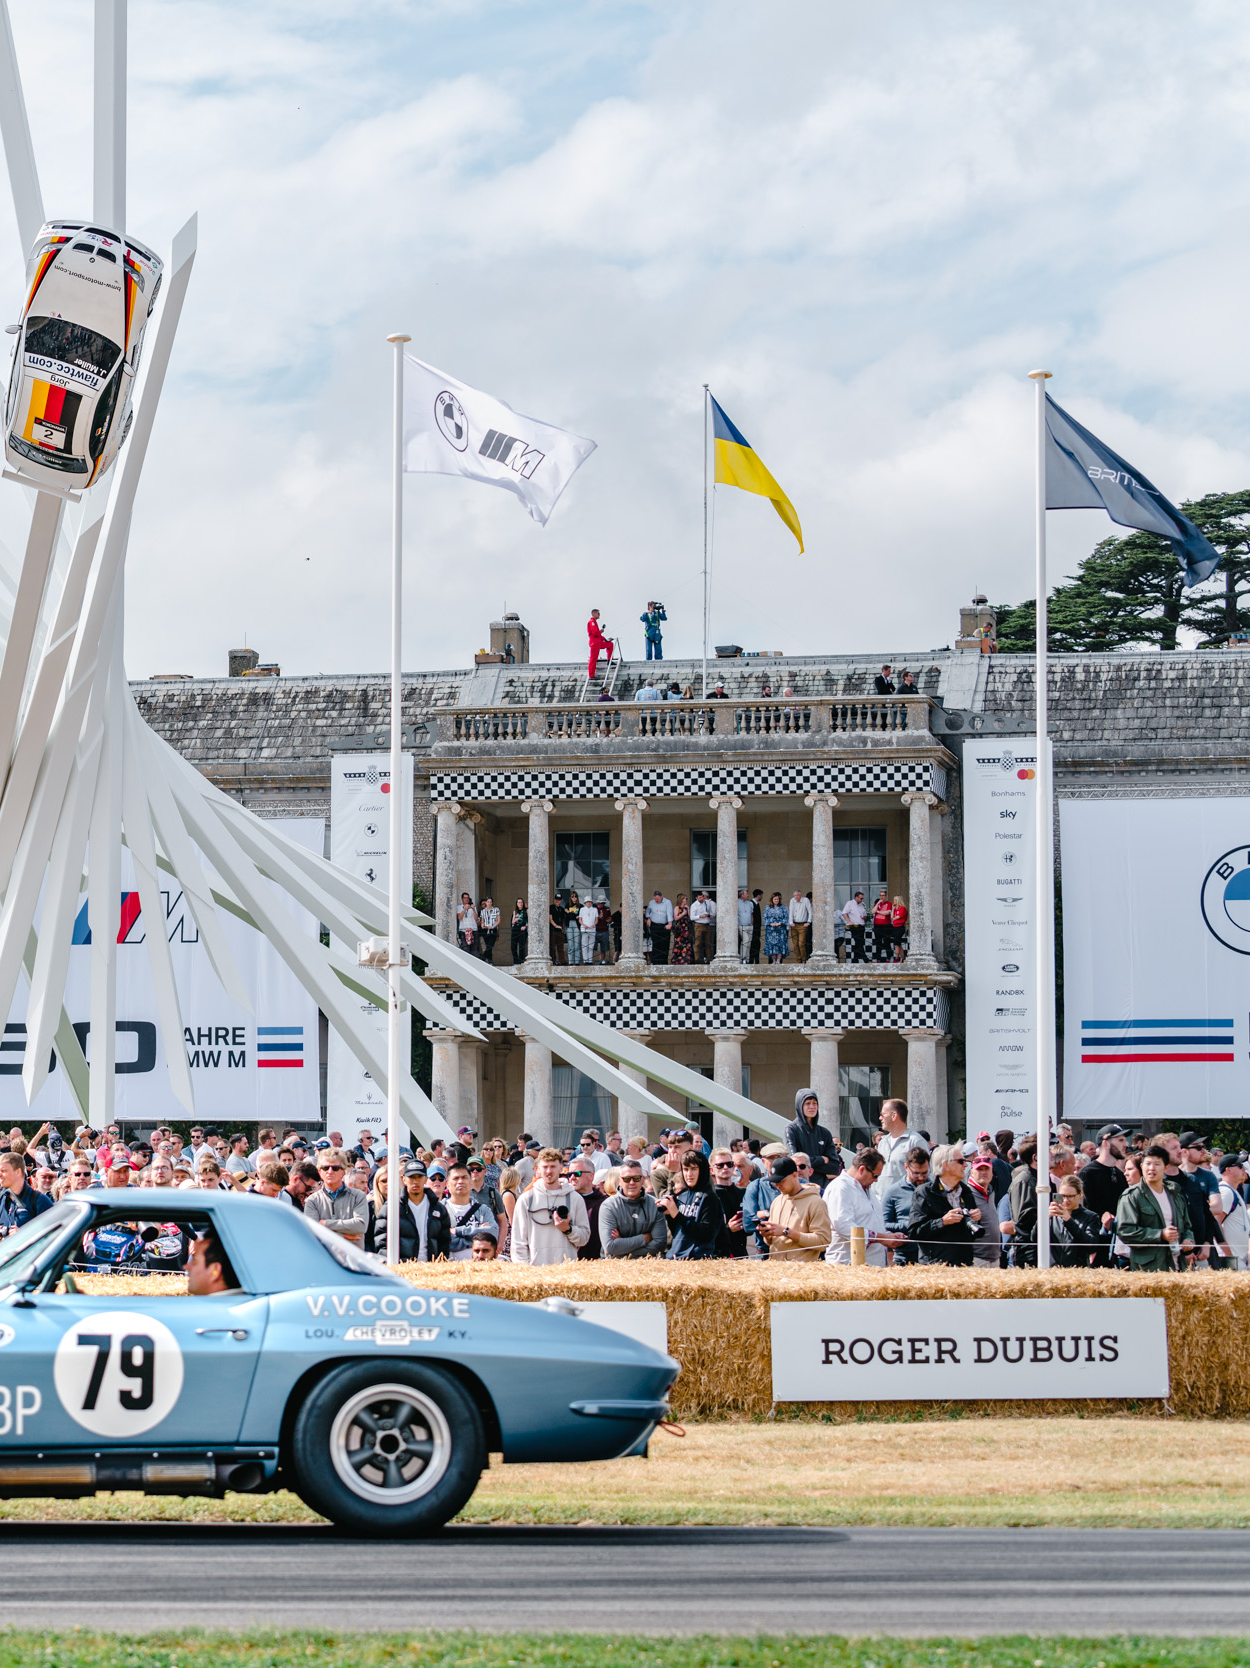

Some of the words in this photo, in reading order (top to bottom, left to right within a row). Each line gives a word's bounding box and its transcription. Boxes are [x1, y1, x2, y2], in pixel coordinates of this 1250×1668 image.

[54, 264, 121, 292] bmw-motorsport.com
[28, 355, 99, 387] fiawtcc.com
[74, 358, 99, 374] Müller
[43, 429, 54, 440] 2
[359, 804, 385, 812] Cartier
[999, 809, 1017, 820] sky
[994, 832, 1023, 840] Polestar
[184, 1027, 246, 1045] AHRE
[187, 1050, 222, 1068] MW
[228, 1050, 246, 1068] M
[1000, 1109, 1023, 1119] pulse
[305, 1328, 340, 1339] LOU.
[352, 1327, 434, 1339] CHEVROLET
[447, 1330, 473, 1341] KY.
[821, 1337, 961, 1365] ROGER
[973, 1335, 1120, 1364] DUBUIS
[76, 1334, 156, 1411] 79
